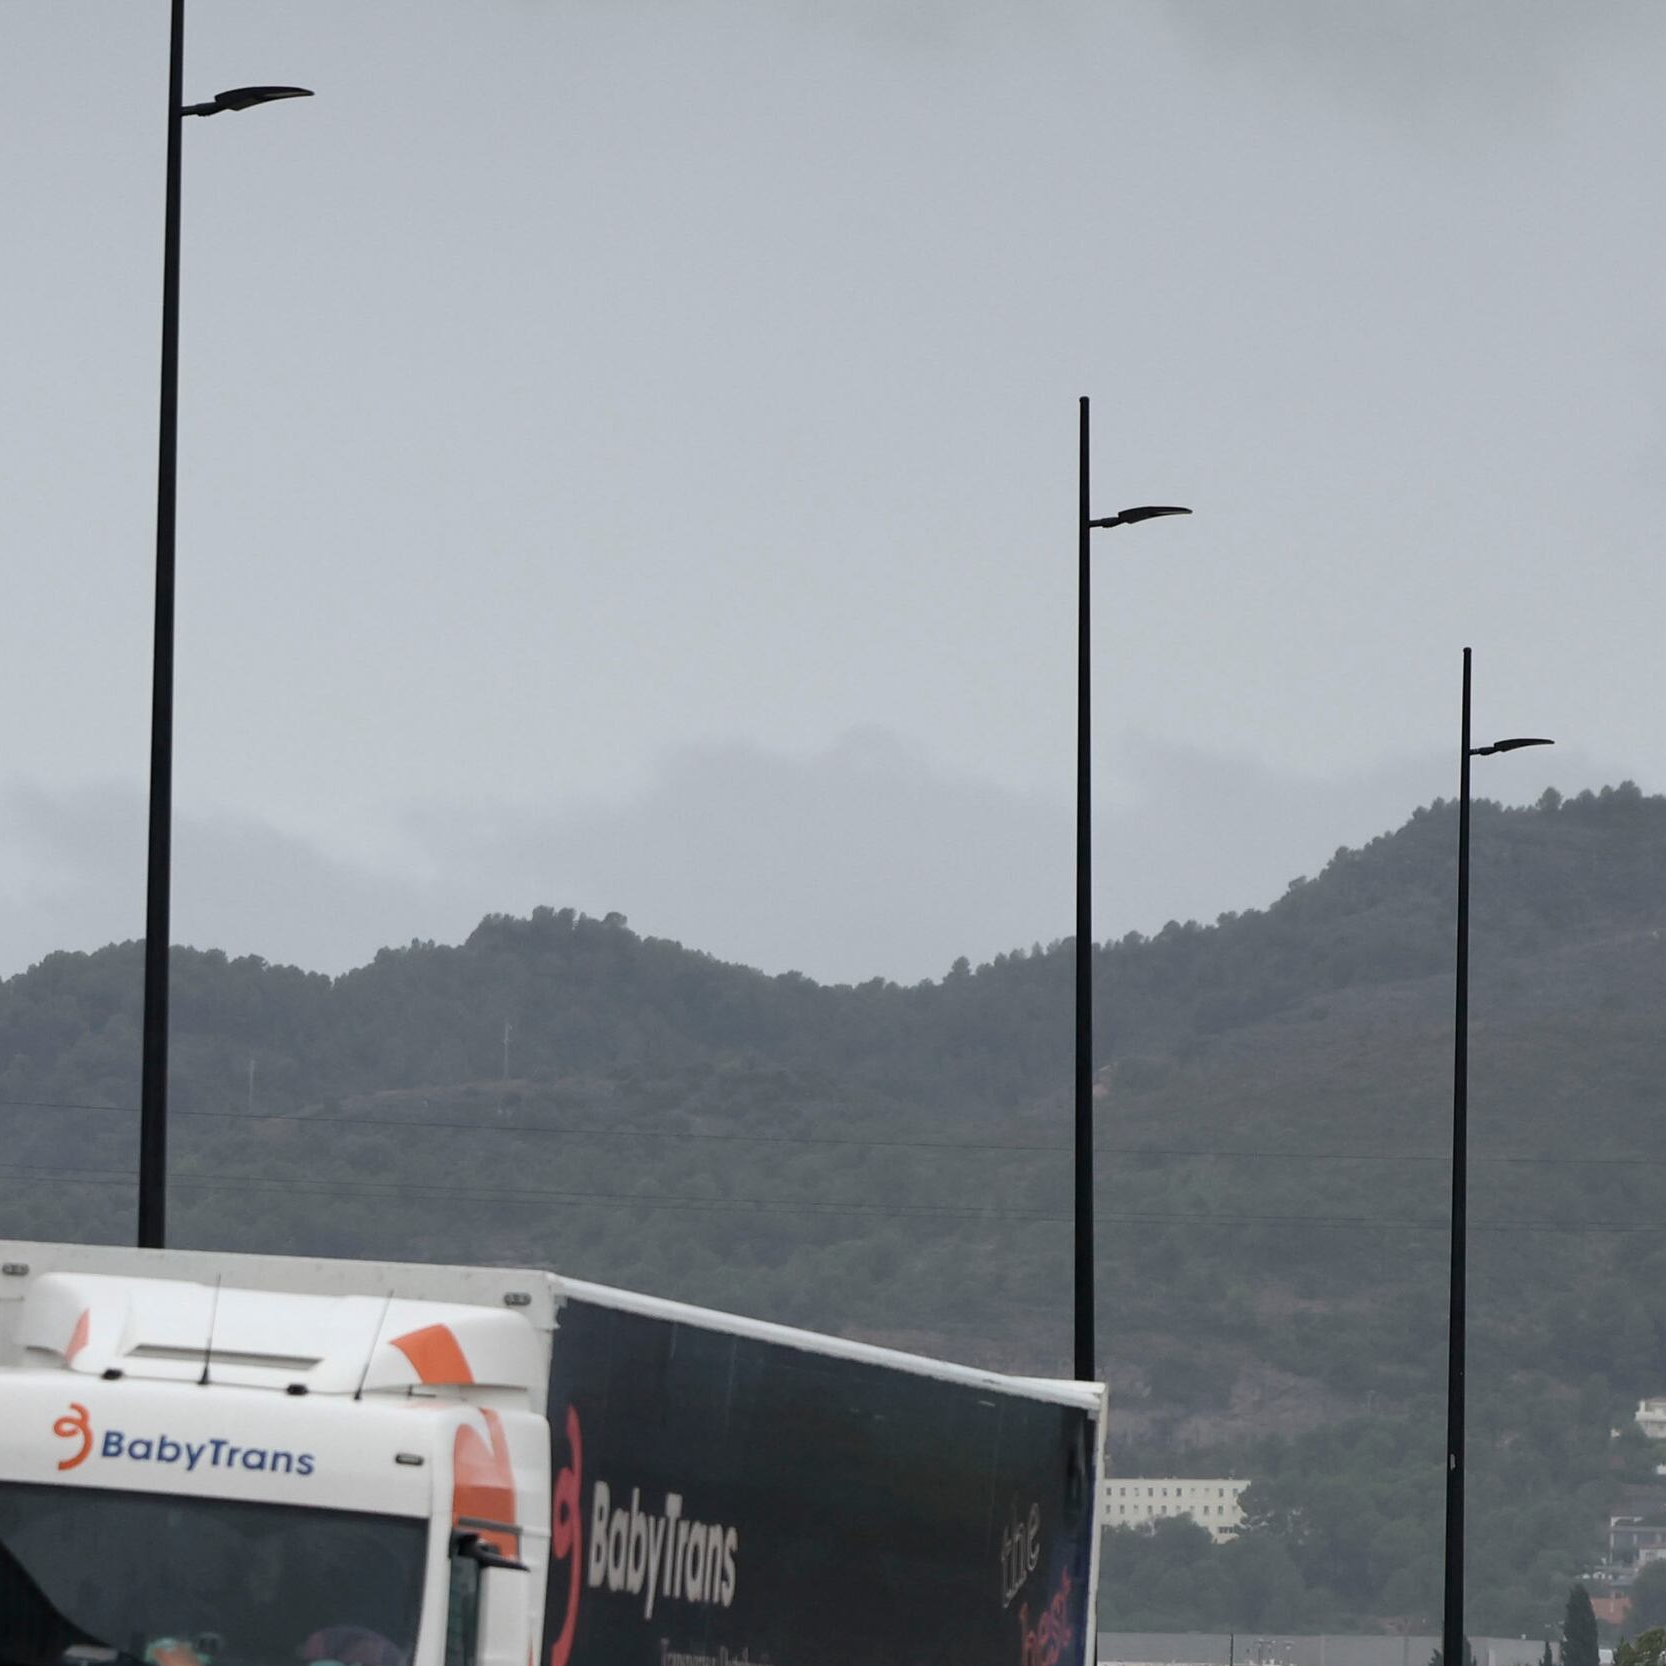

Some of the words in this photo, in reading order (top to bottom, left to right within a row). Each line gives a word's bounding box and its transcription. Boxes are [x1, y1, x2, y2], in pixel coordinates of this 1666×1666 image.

[101, 1430, 316, 1475] BabyTrans
[588, 1480, 738, 1619] BabyTrans
[1002, 1503, 1040, 1607] the
